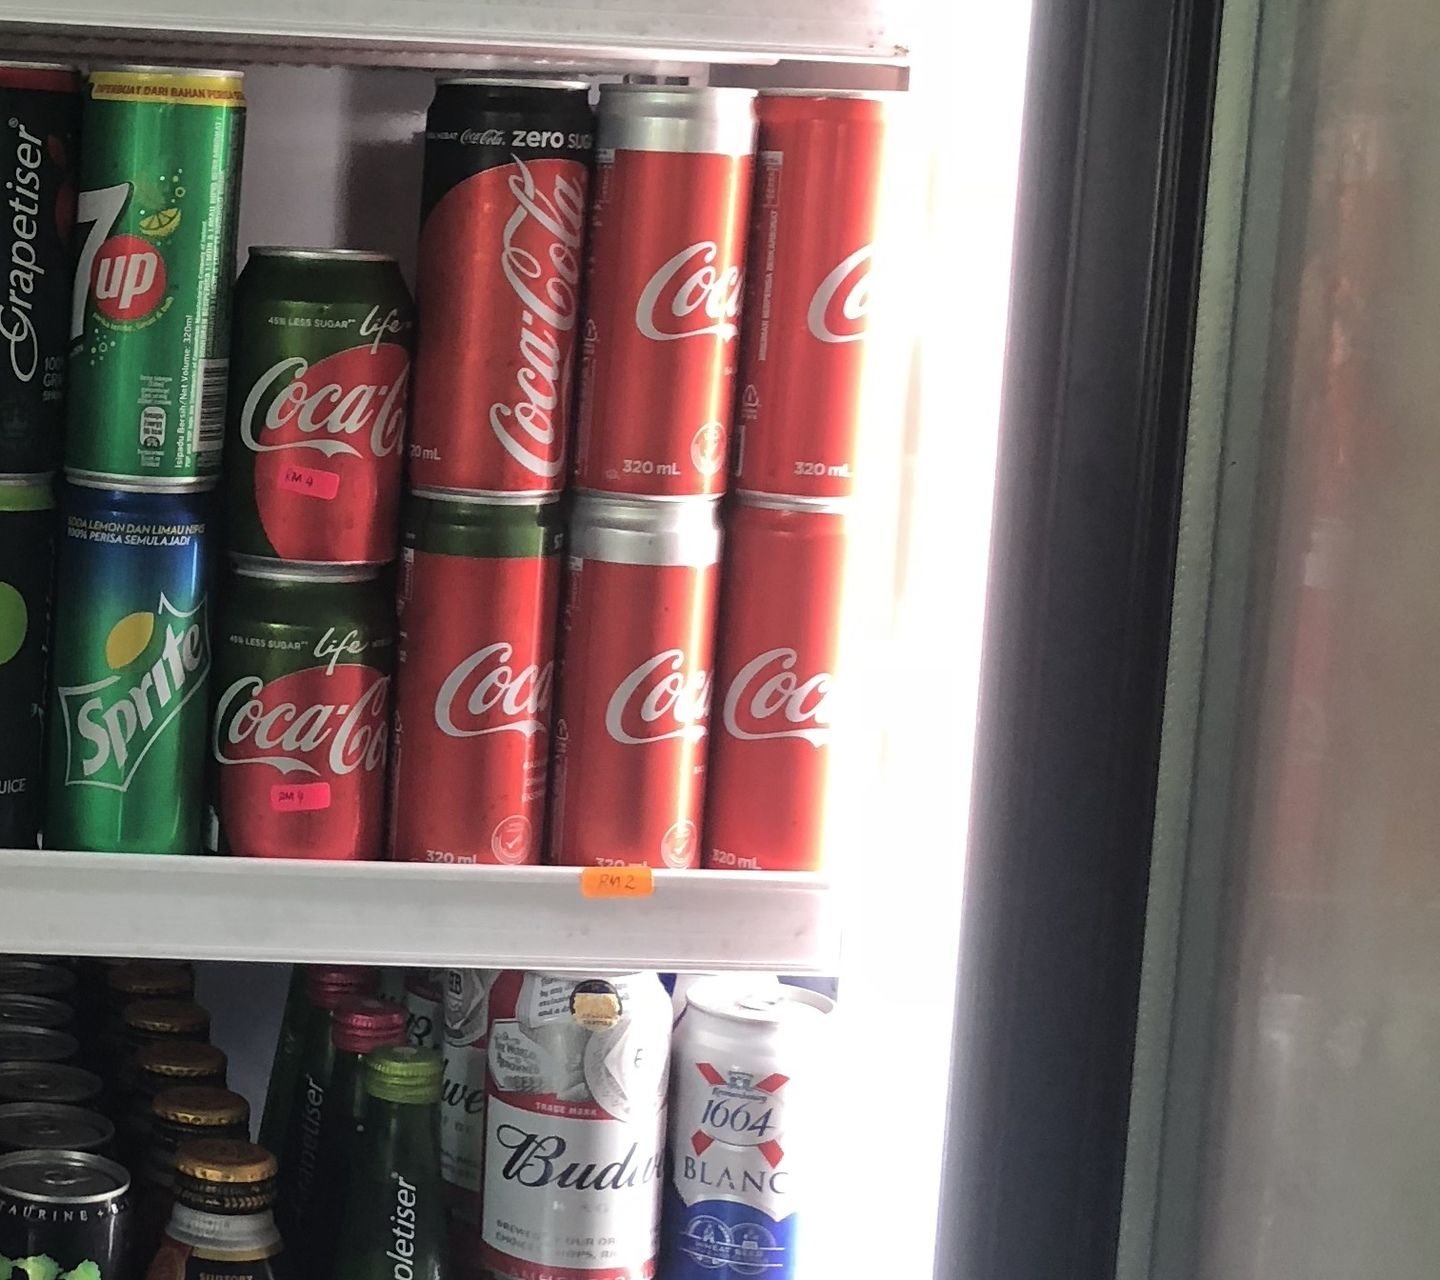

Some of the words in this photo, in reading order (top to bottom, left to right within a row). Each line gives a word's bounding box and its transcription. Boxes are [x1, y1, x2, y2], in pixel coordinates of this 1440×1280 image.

[512, 128, 565, 148] zero
[70, 182, 134, 340] 7
[96, 251, 157, 310] up
[359, 306, 405, 354] life
[488, 153, 586, 478] Coca-Cola
[623, 458, 653, 476] 320
[794, 461, 823, 477] 320
[126, 523, 151, 534] DAN
[152, 524, 186, 536] LIMAU
[314, 628, 369, 675] life
[77, 622, 202, 776] Sprite
[624, 870, 638, 890] 2
[702, 1098, 774, 1138] 1664
[684, 1154, 790, 1195] BLANC
